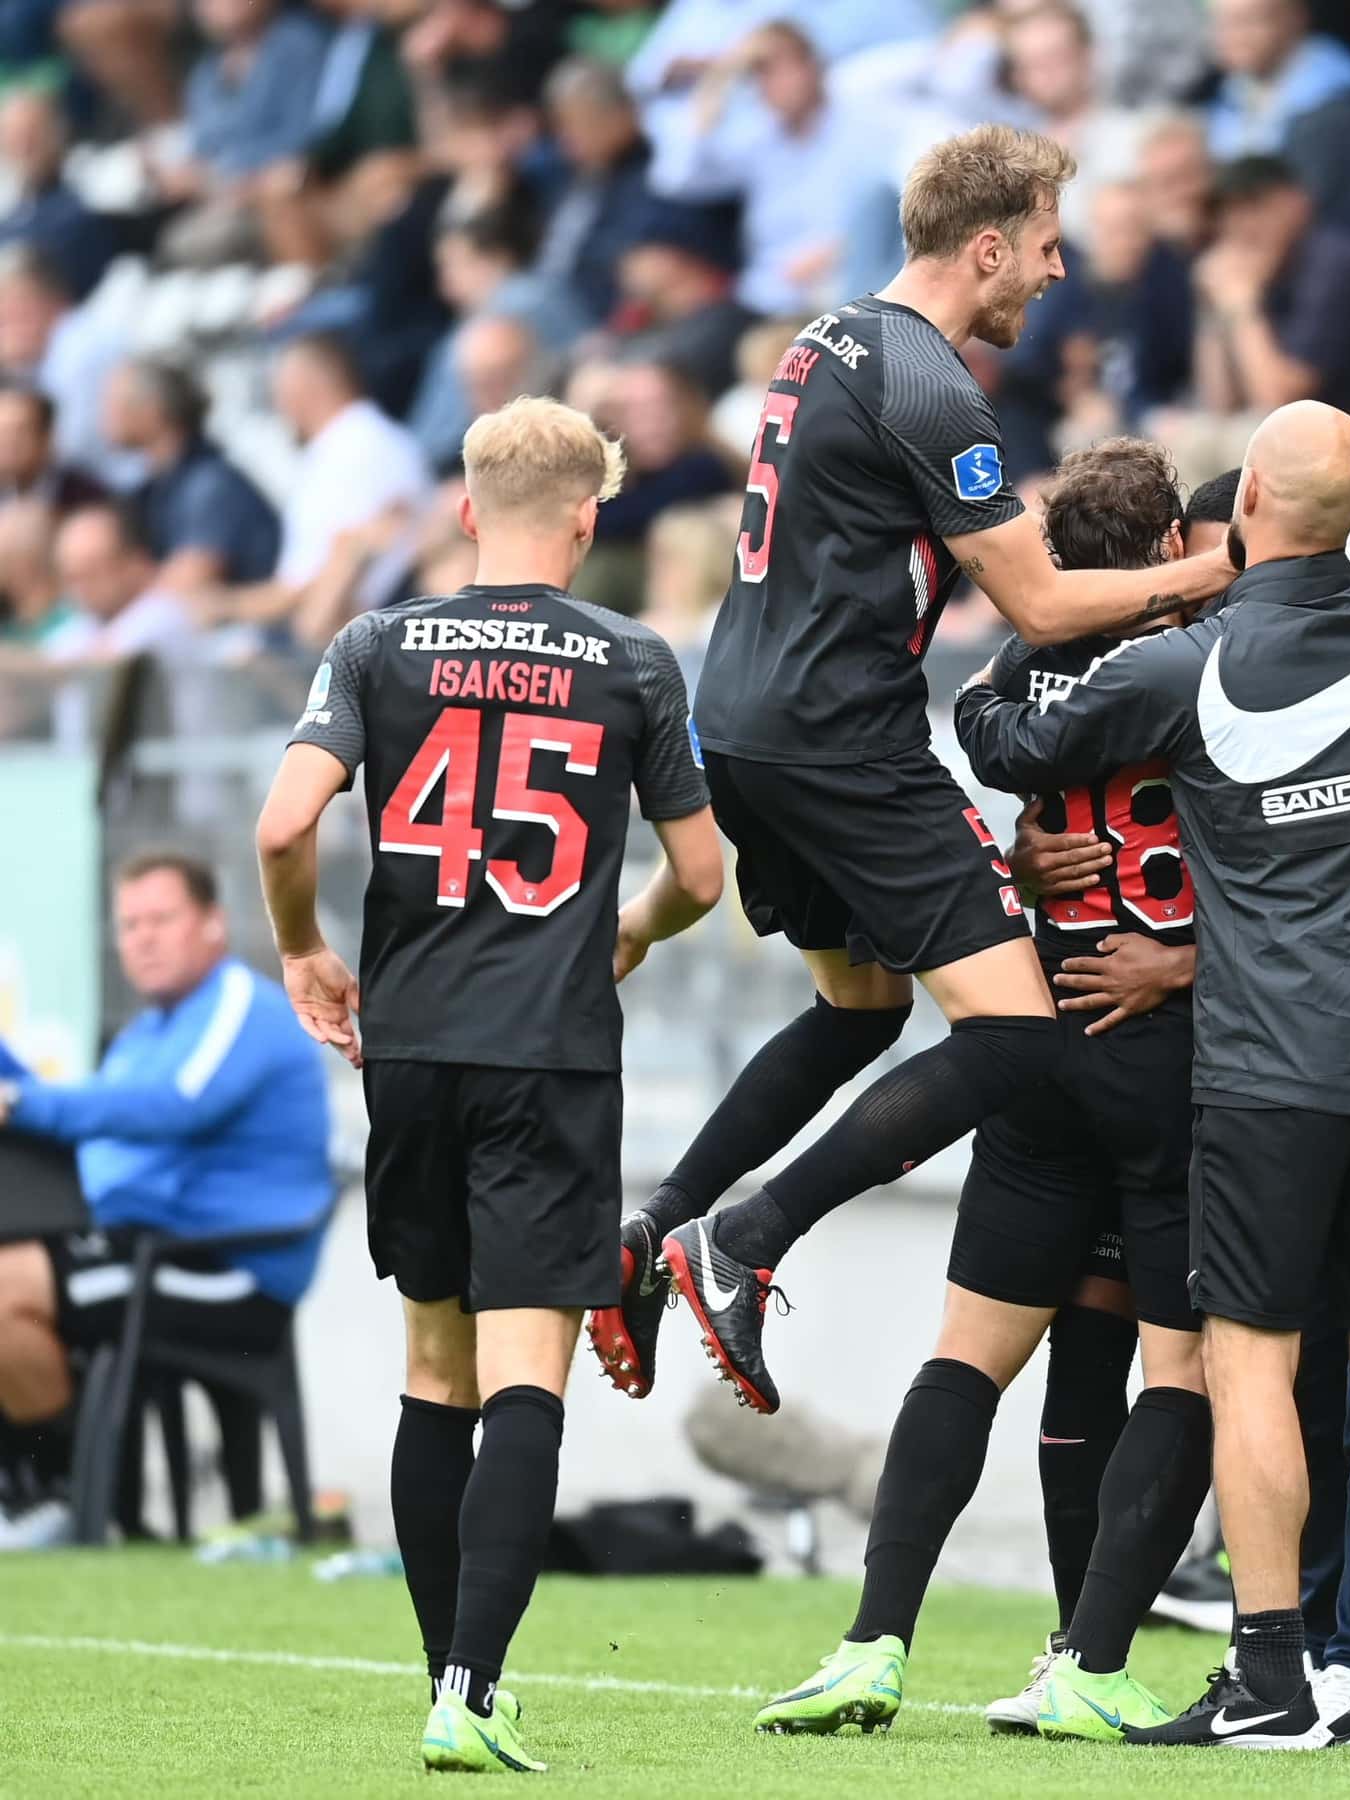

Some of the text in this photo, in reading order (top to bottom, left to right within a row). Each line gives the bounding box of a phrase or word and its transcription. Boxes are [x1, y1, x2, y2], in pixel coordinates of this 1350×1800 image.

[401, 618, 610, 665] HESSEL.DK
[429, 658, 573, 708] ISAKSEN
[379, 706, 604, 917] 45
